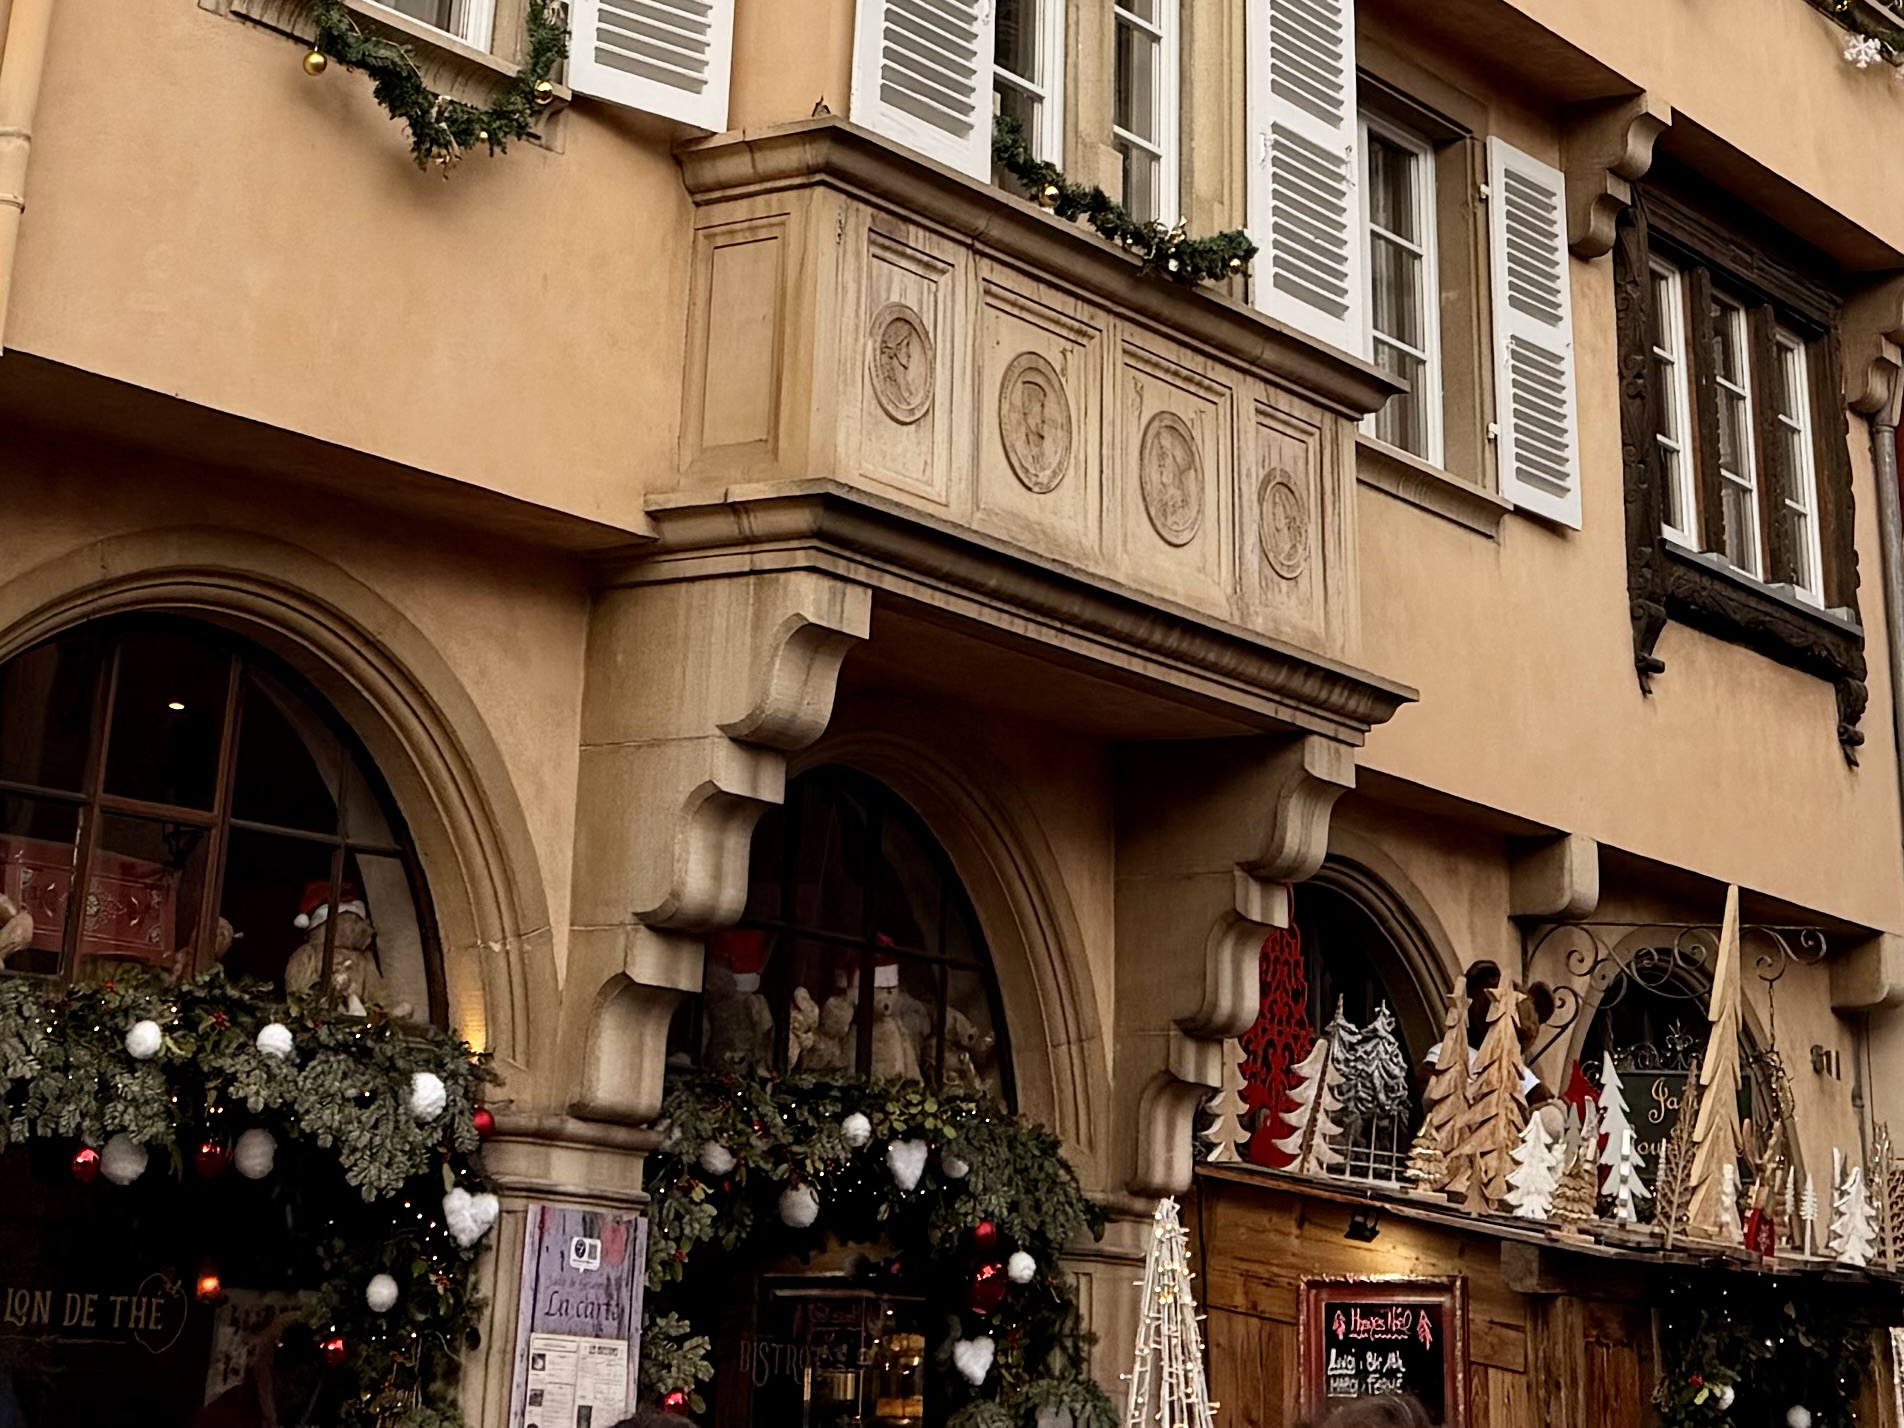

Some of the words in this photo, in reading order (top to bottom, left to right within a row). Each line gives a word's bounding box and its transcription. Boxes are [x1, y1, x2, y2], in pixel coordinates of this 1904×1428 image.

[62, 1292, 99, 1327] DE
[544, 1290, 570, 1317] La
[576, 1297, 620, 1321] carte
